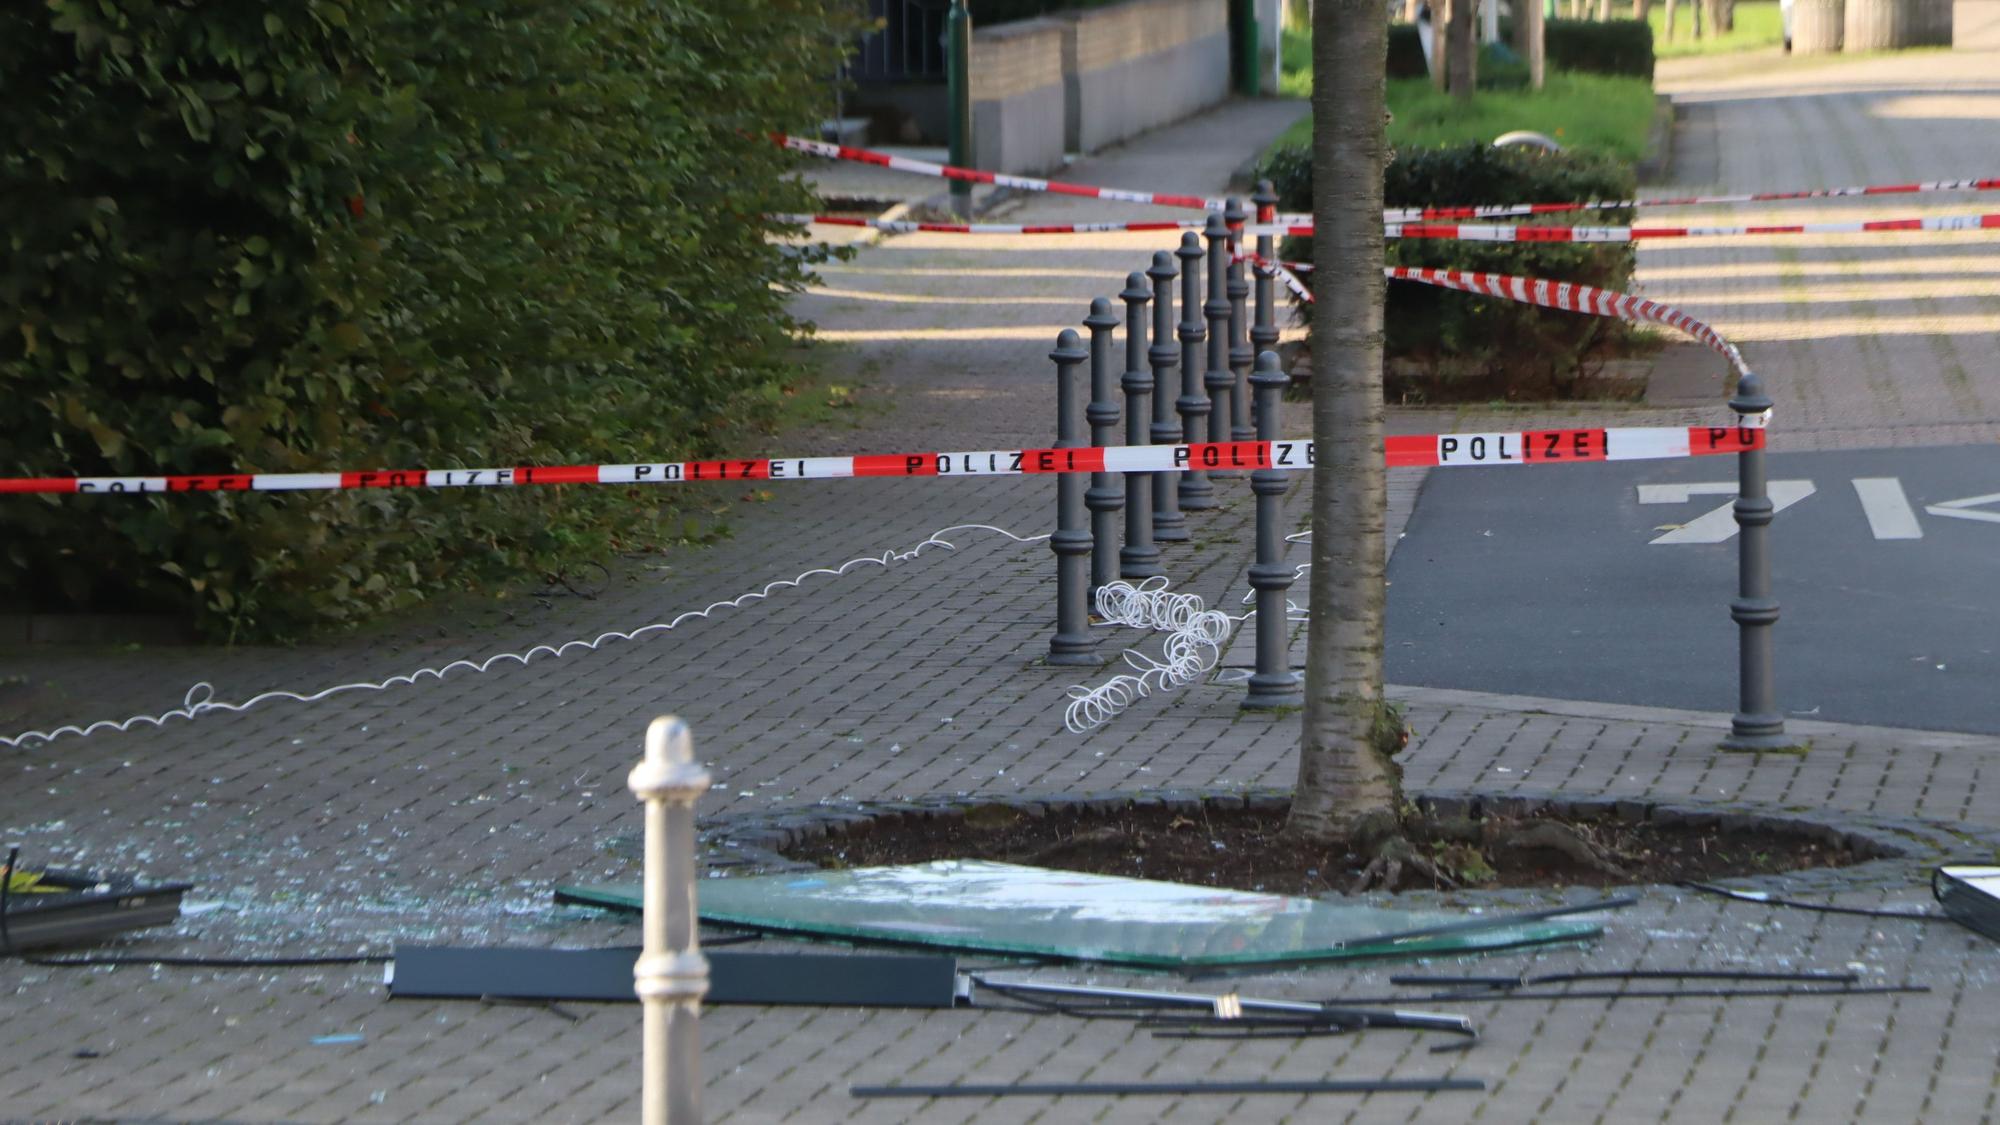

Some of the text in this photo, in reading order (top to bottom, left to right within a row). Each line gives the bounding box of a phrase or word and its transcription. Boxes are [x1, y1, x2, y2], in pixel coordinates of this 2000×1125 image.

[634, 460, 804, 480] POLIZEI
[906, 450, 1074, 474] POLIZEI
[1173, 443, 1315, 468] POLIZE
[1441, 432, 1608, 461] POLIZEI
